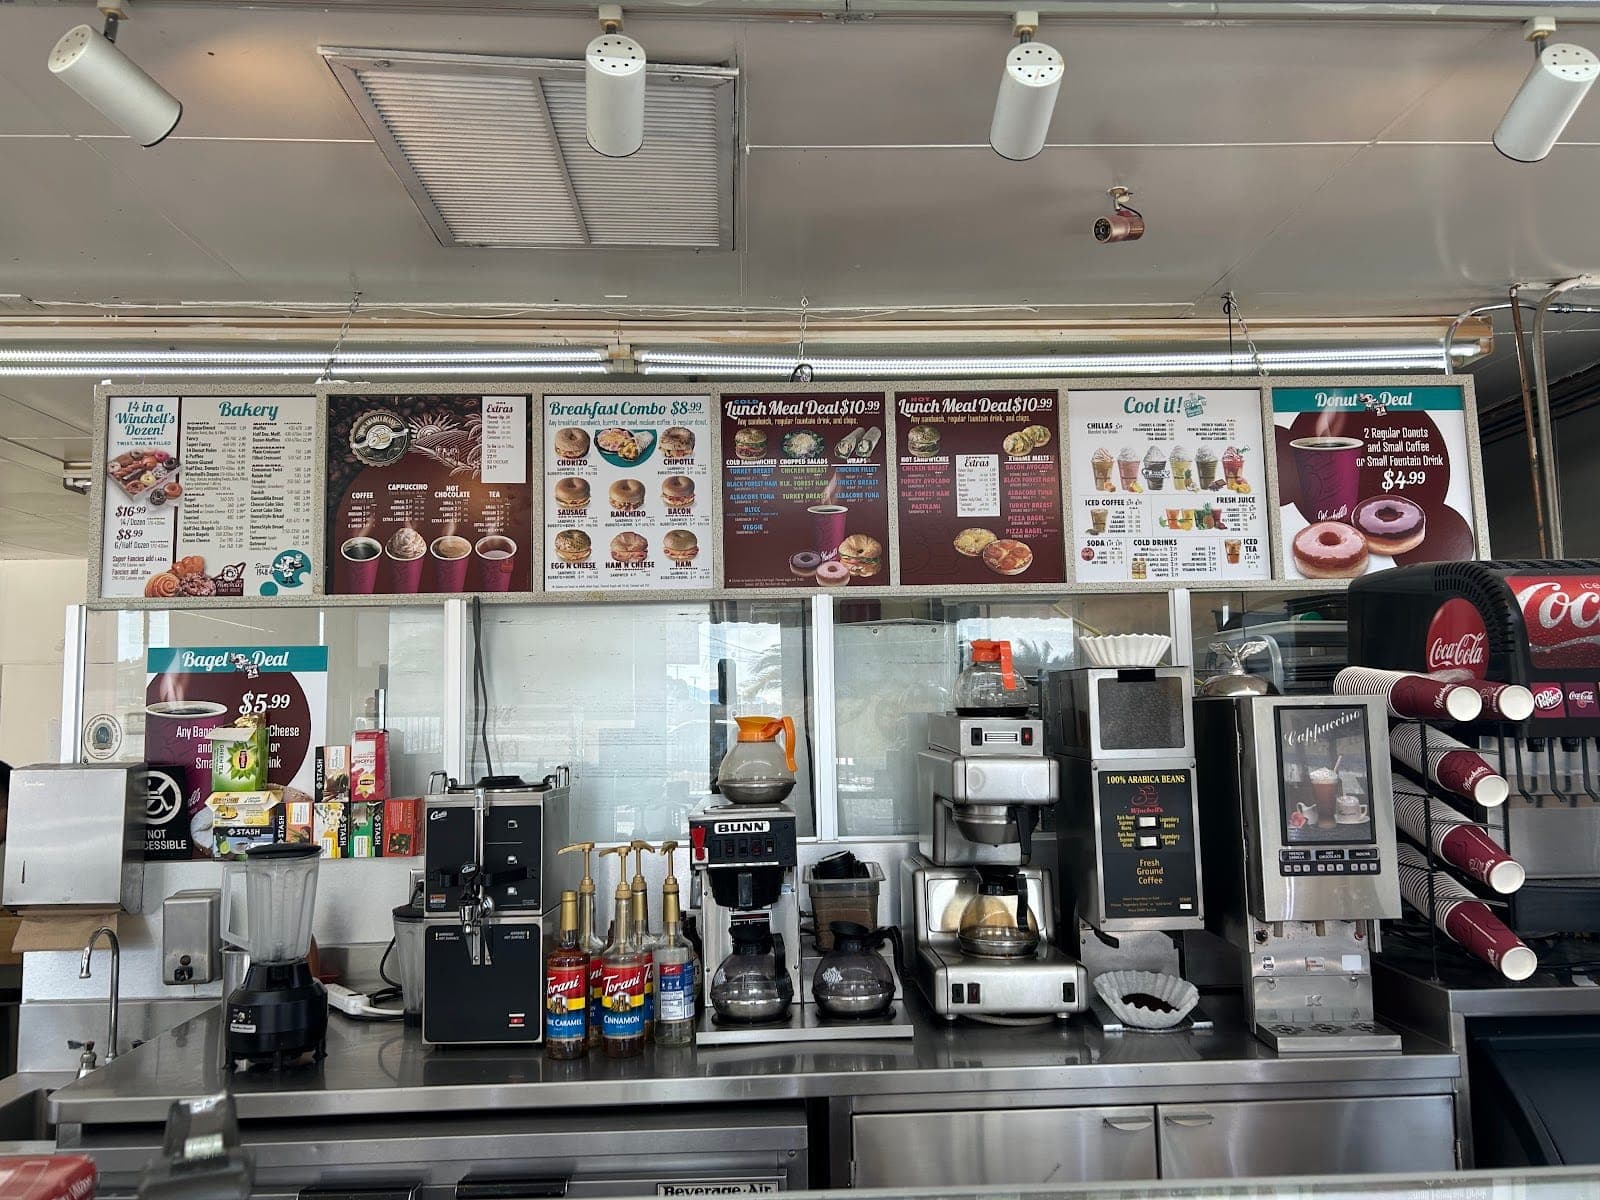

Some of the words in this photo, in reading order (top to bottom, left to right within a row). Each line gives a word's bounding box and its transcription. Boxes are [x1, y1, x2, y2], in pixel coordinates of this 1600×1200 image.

[1124, 396, 1159, 414] Cool
[1163, 396, 1183, 414] it!
[1315, 392, 1358, 407] Donut
[1379, 392, 1412, 407] Deal
[128, 402, 139, 412] 14
[142, 402, 152, 412] in
[156, 402, 163, 412] a
[219, 401, 278, 420] Bakery
[486, 404, 513, 413] Extras
[550, 401, 619, 419] Breakfast
[621, 402, 666, 415] Combo
[671, 401, 702, 416] $8.99
[725, 400, 765, 420] Lunch
[768, 400, 803, 415] Meal
[809, 401, 839, 415] Deal
[840, 398, 880, 416] $10.99
[898, 398, 939, 417] Lunch
[942, 398, 976, 412] Meal
[978, 398, 1012, 412] Deal
[1012, 396, 1053, 414] $10.99
[116, 412, 175, 423] Winchell's
[124, 424, 165, 436] Dozen!
[1364, 429, 1369, 438] 2
[1372, 428, 1400, 440] Regular
[1402, 428, 1428, 437] Donuts
[1368, 442, 1381, 452] and
[1383, 442, 1403, 452] Small
[1406, 442, 1429, 452] Coffee
[964, 459, 989, 467] Extras
[1356, 458, 1365, 466] or
[1367, 455, 1388, 466] Small
[1390, 455, 1421, 466] Fountain
[1423, 455, 1443, 466] Drink
[1382, 468, 1426, 493] $4.99
[115, 506, 146, 518] $16.99
[116, 528, 143, 541] $8.99
[1430, 632, 1486, 667] Coca-Cola
[182, 651, 227, 671] Bagel
[252, 651, 288, 666] Deal
[239, 691, 290, 715] $5.99
[1535, 693, 1562, 708] Pepper
[176, 726, 191, 739] Any
[270, 726, 300, 736] Cheese
[1284, 710, 1360, 746] Cappuccino
[198, 742, 212, 753] and
[271, 744, 280, 753] or
[1106, 775, 1126, 784] 100%
[1128, 775, 1159, 784] ARABICA
[1162, 775, 1185, 784] BEANS
[148, 830, 167, 838] NOT
[718, 823, 764, 832] BUNN
[547, 975, 579, 996] Torani
[603, 972, 640, 996] Torani
[604, 1016, 640, 1024] CINNAMON
